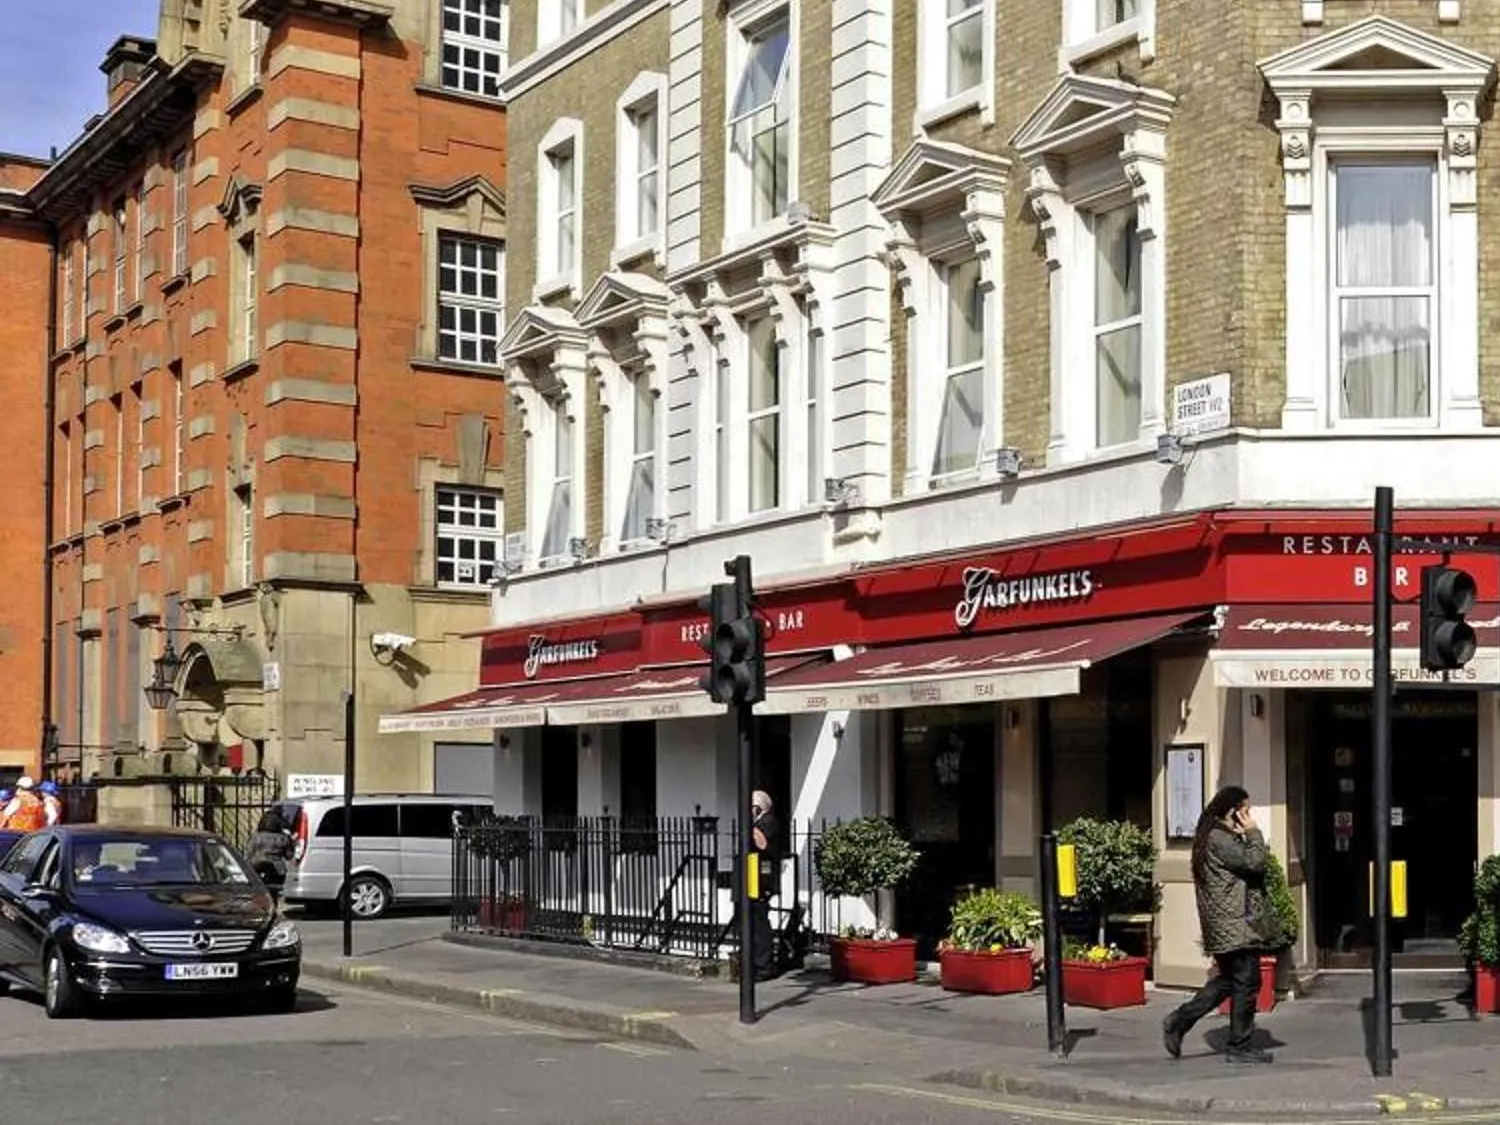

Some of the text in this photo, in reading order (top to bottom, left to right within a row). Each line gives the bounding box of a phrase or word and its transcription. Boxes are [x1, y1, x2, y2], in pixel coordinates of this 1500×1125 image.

[1177, 382, 1211, 403] LONDON
[1177, 400, 1206, 420] STREET
[1354, 567, 1409, 586] BR
[955, 566, 1093, 627] GARFUNKEL'S
[778, 610, 804, 631] BAR
[1255, 667, 1335, 682] WELCOME
[1339, 667, 1361, 682] TO
